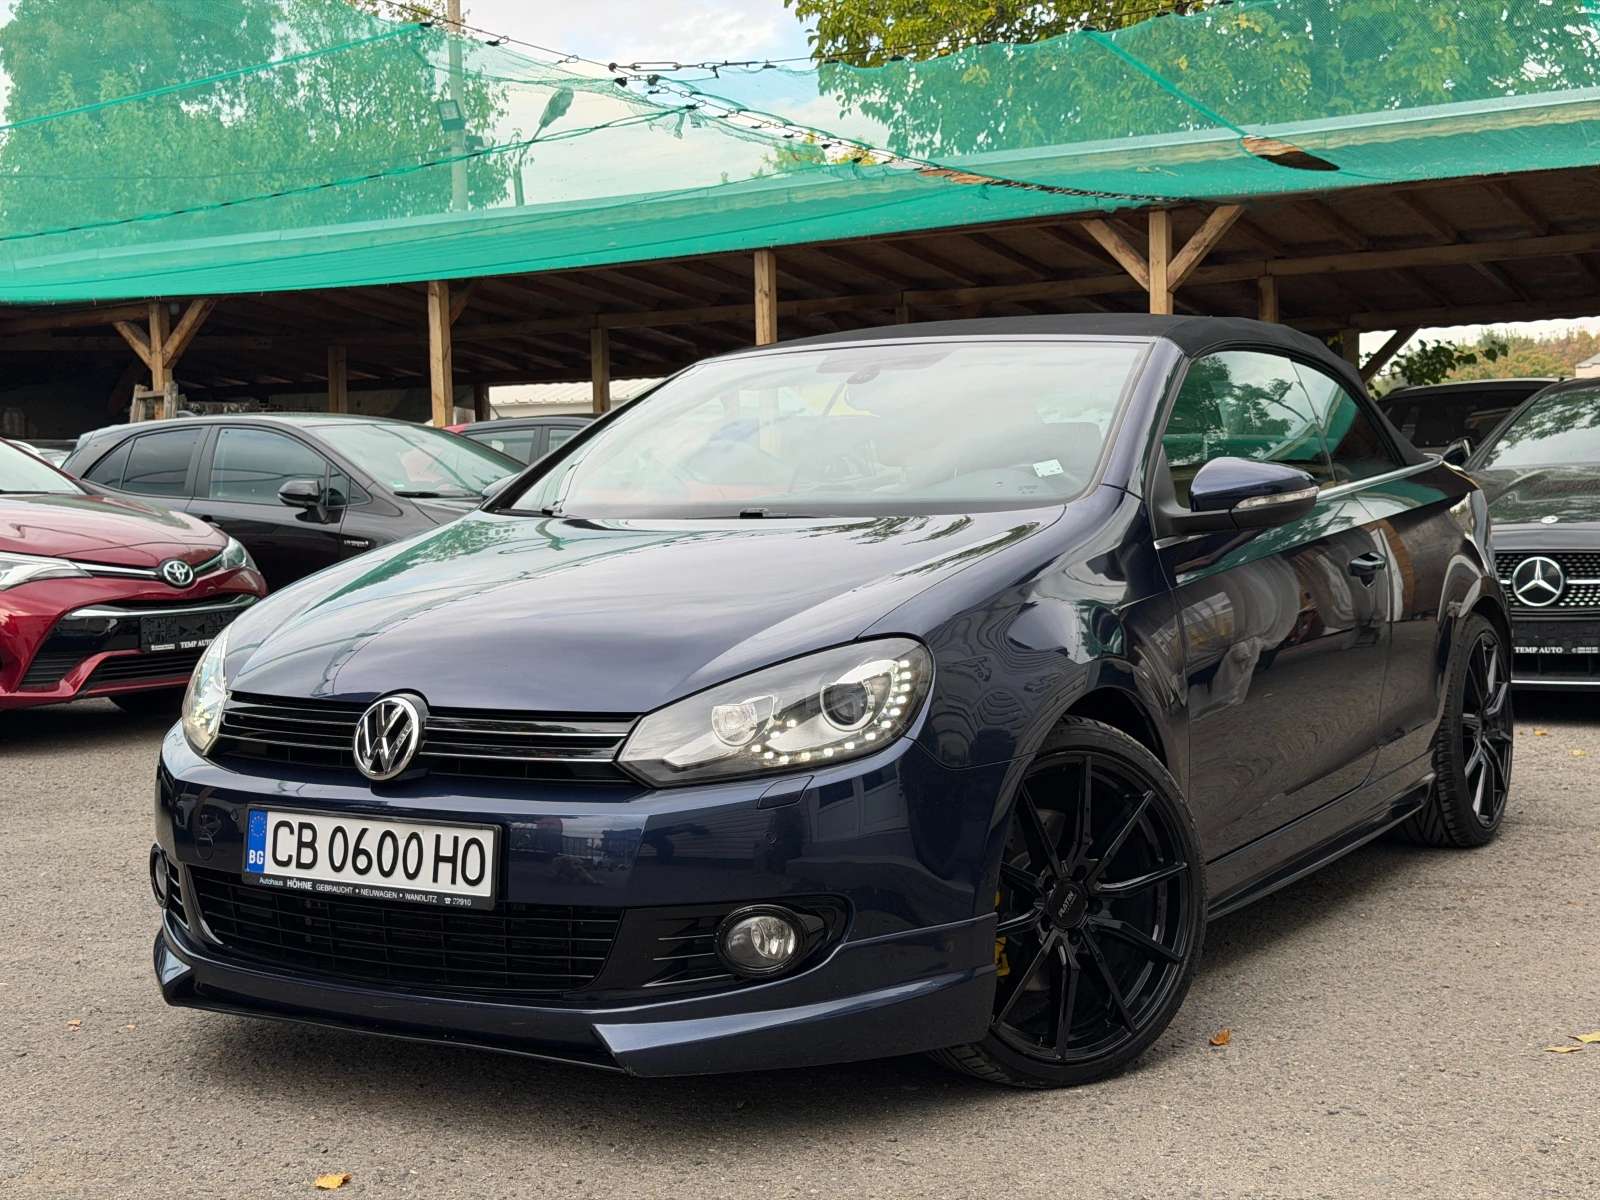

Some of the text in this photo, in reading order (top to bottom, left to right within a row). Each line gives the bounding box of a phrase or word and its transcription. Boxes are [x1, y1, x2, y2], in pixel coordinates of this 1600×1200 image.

[180, 640, 197, 649] TEMP
[1514, 646, 1538, 654] TEMP
[1539, 646, 1563, 654] AUTO
[249, 849, 264, 865] BG
[271, 820, 318, 870] CB
[328, 826, 423, 880] 0600
[259, 876, 472, 906] Autohaus HÖHNE GEBRAUCHT NEUWAGEN WANDLITZ 22910
[1058, 890, 1074, 918] PLATIN
